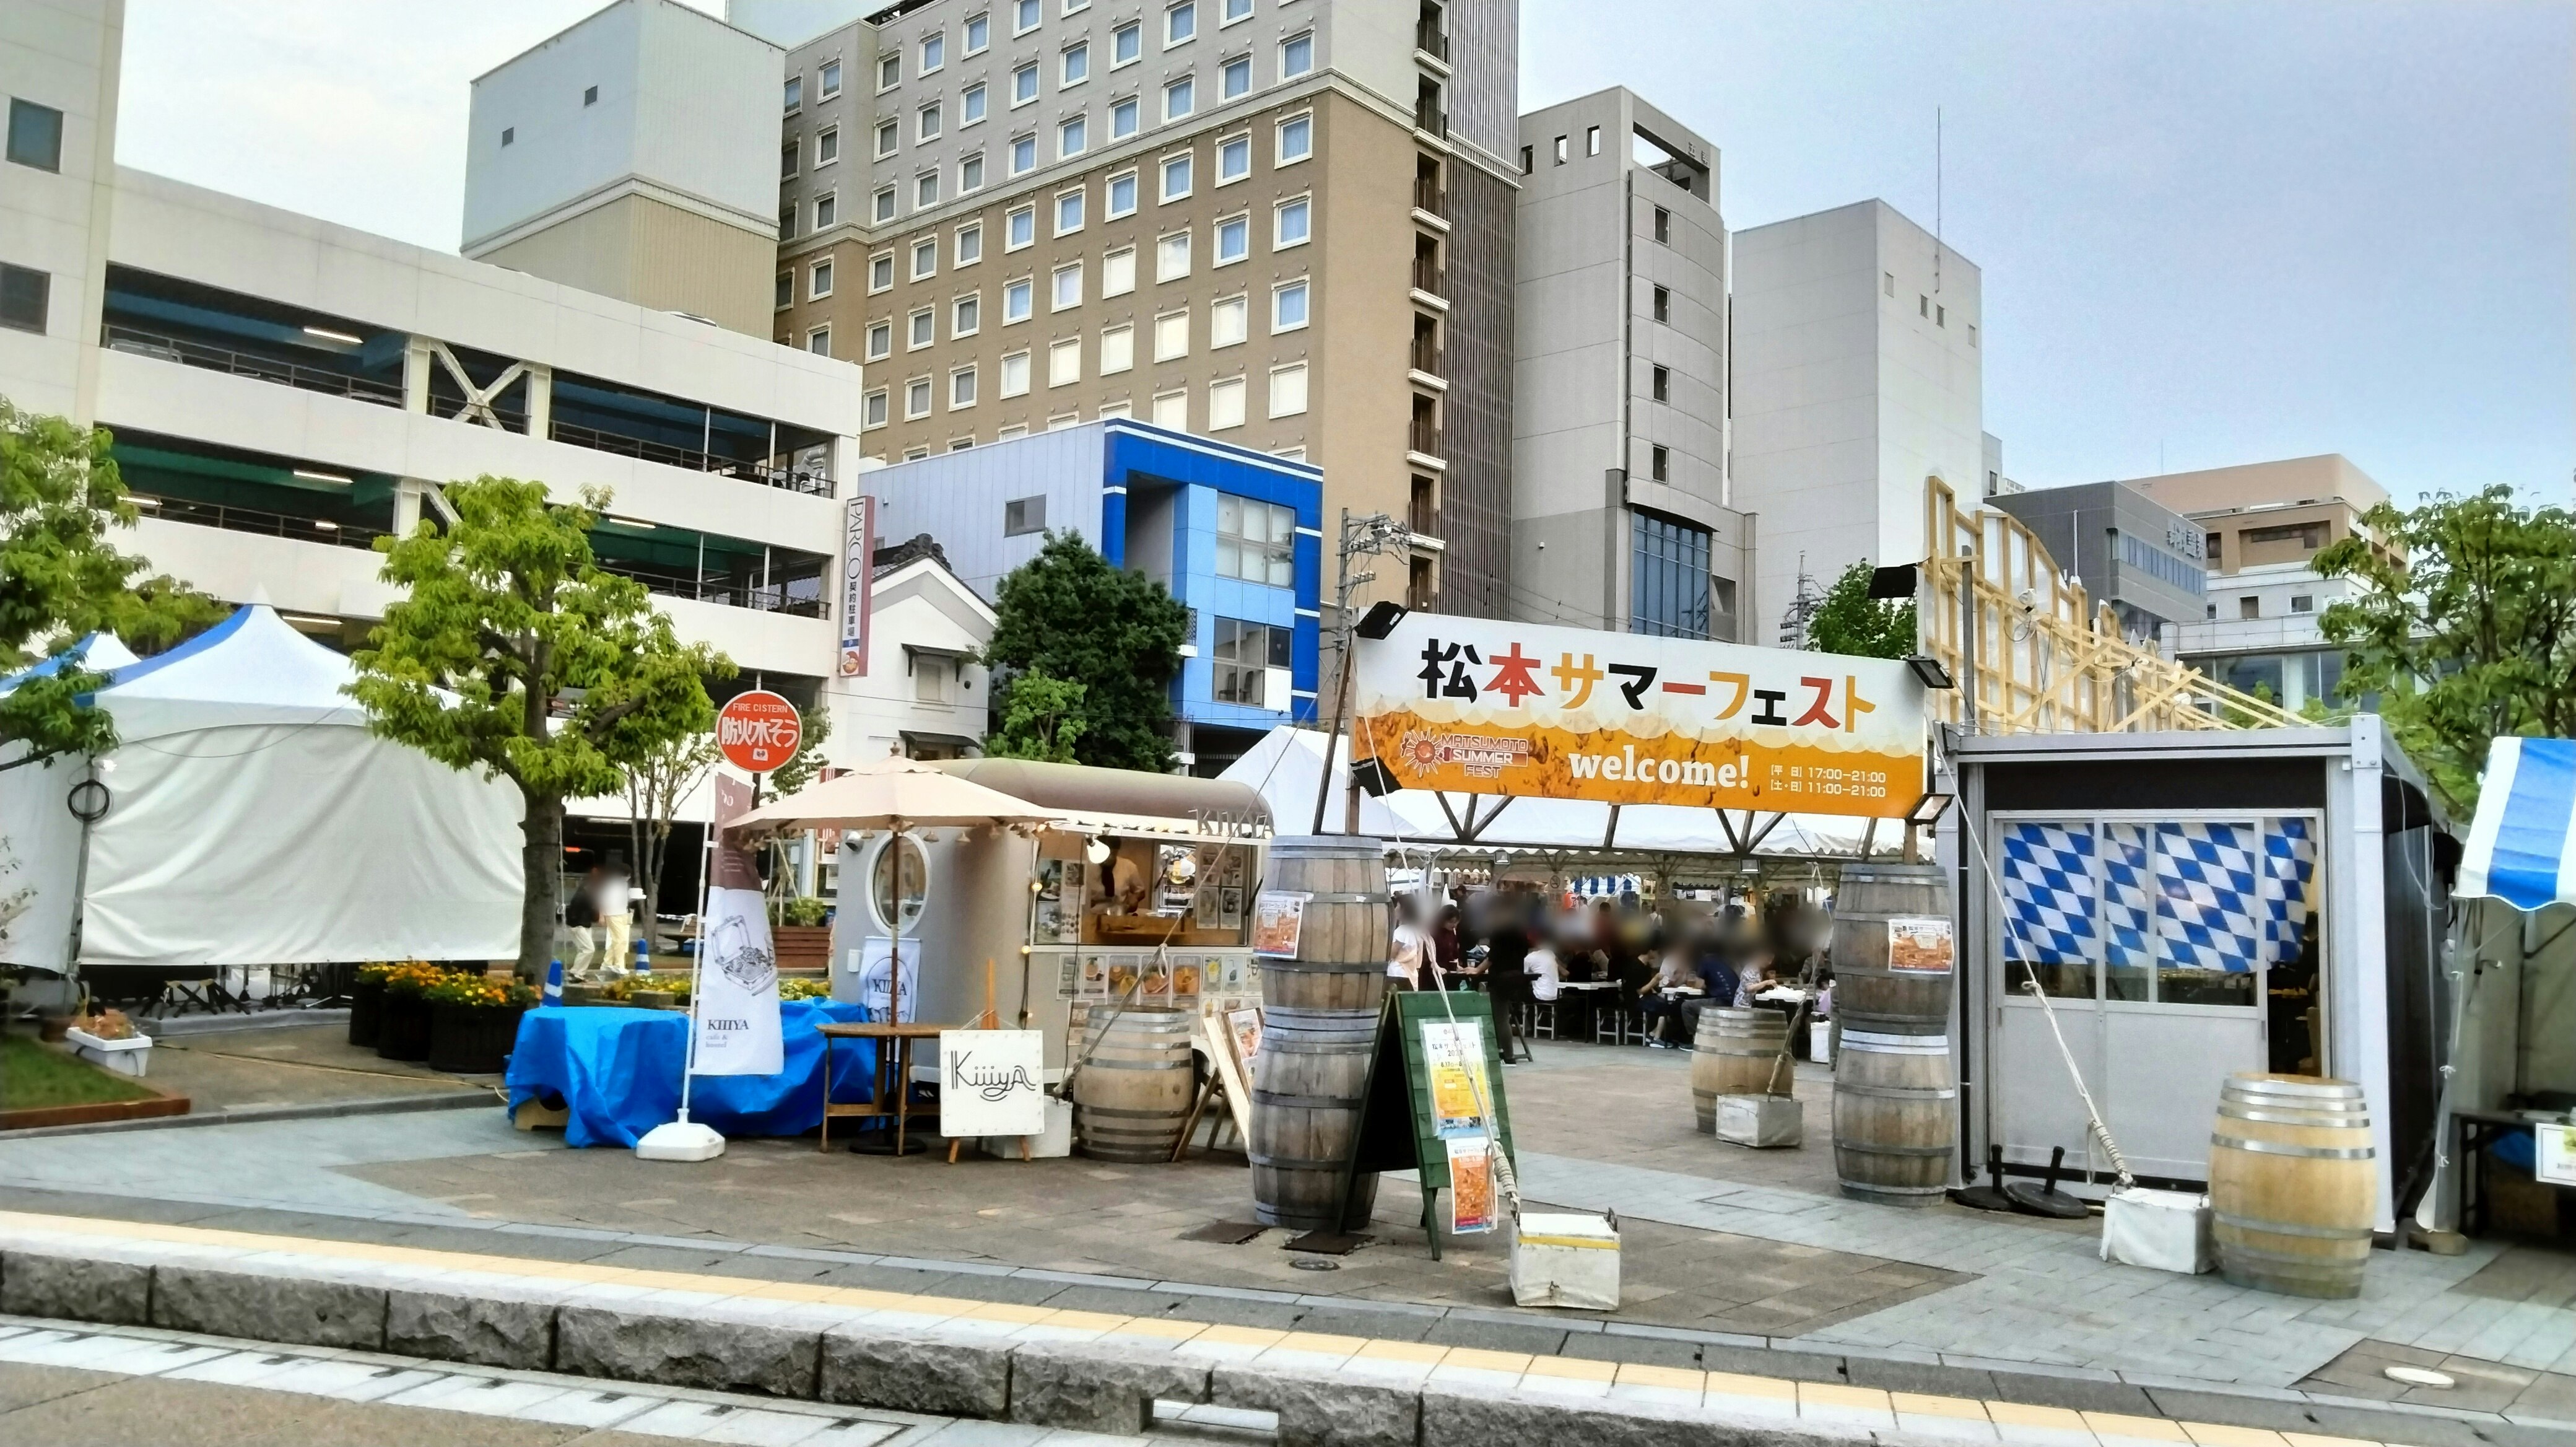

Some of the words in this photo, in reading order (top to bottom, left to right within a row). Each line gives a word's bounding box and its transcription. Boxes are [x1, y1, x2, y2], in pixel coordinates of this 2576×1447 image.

[846, 501, 864, 580] PARCO
[1416, 637, 1877, 733] 松本サマーフェスト
[733, 702, 751, 712] FIRE
[753, 704, 788, 713] CISTERN
[1440, 733, 1528, 751] MATSUMOTO
[1453, 748, 1513, 764] SUMMER
[1464, 763, 1502, 779] FEST
[1569, 745, 1749, 789] welcome!
[707, 1019, 749, 1031] KIIIYA
